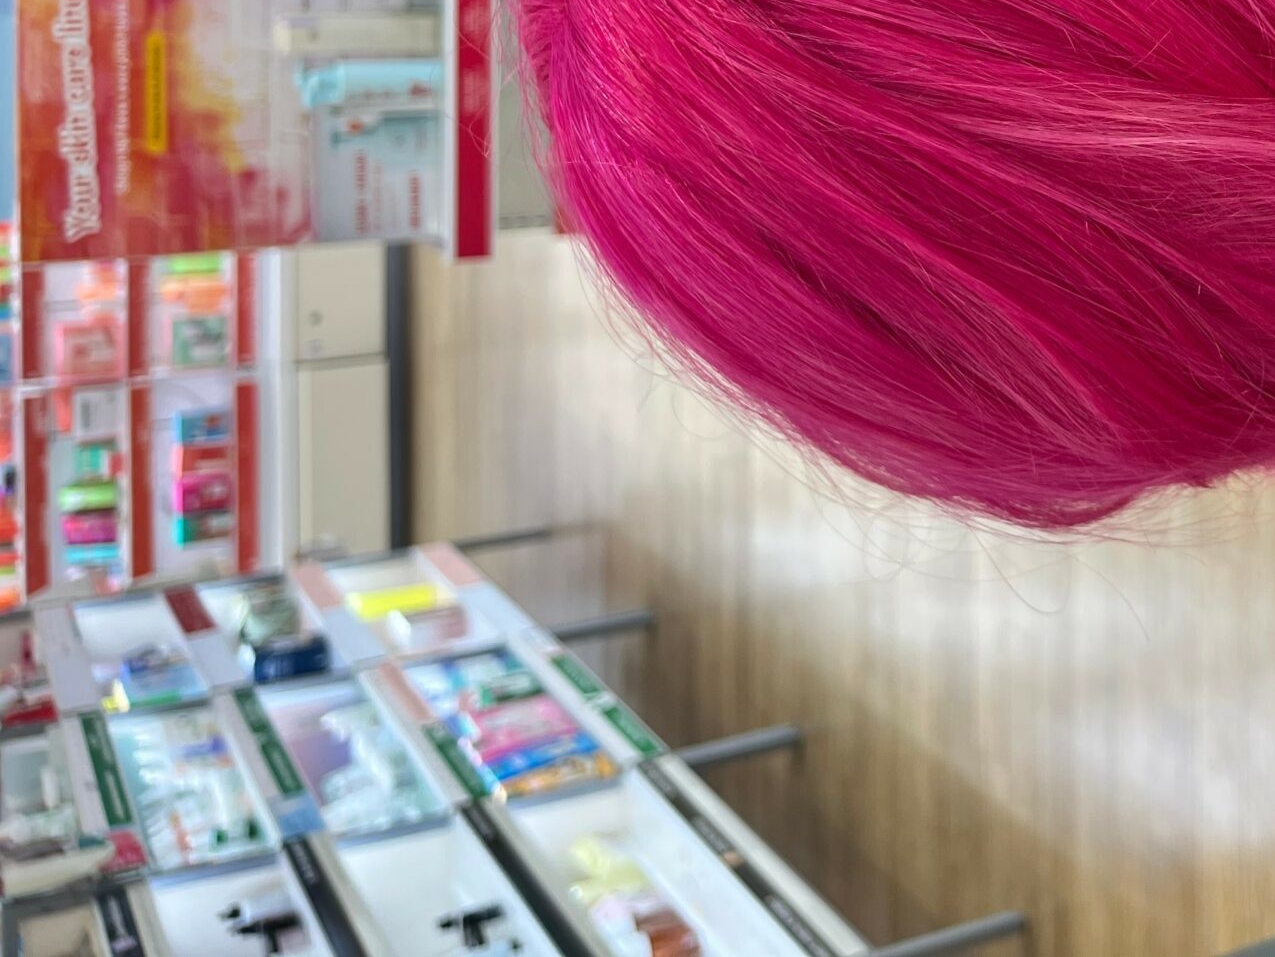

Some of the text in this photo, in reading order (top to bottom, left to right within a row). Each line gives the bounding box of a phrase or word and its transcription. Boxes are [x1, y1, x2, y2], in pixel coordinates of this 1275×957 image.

[66, 45, 90, 101] care
[60, 118, 93, 163] skin
[65, 174, 98, 238] Your
